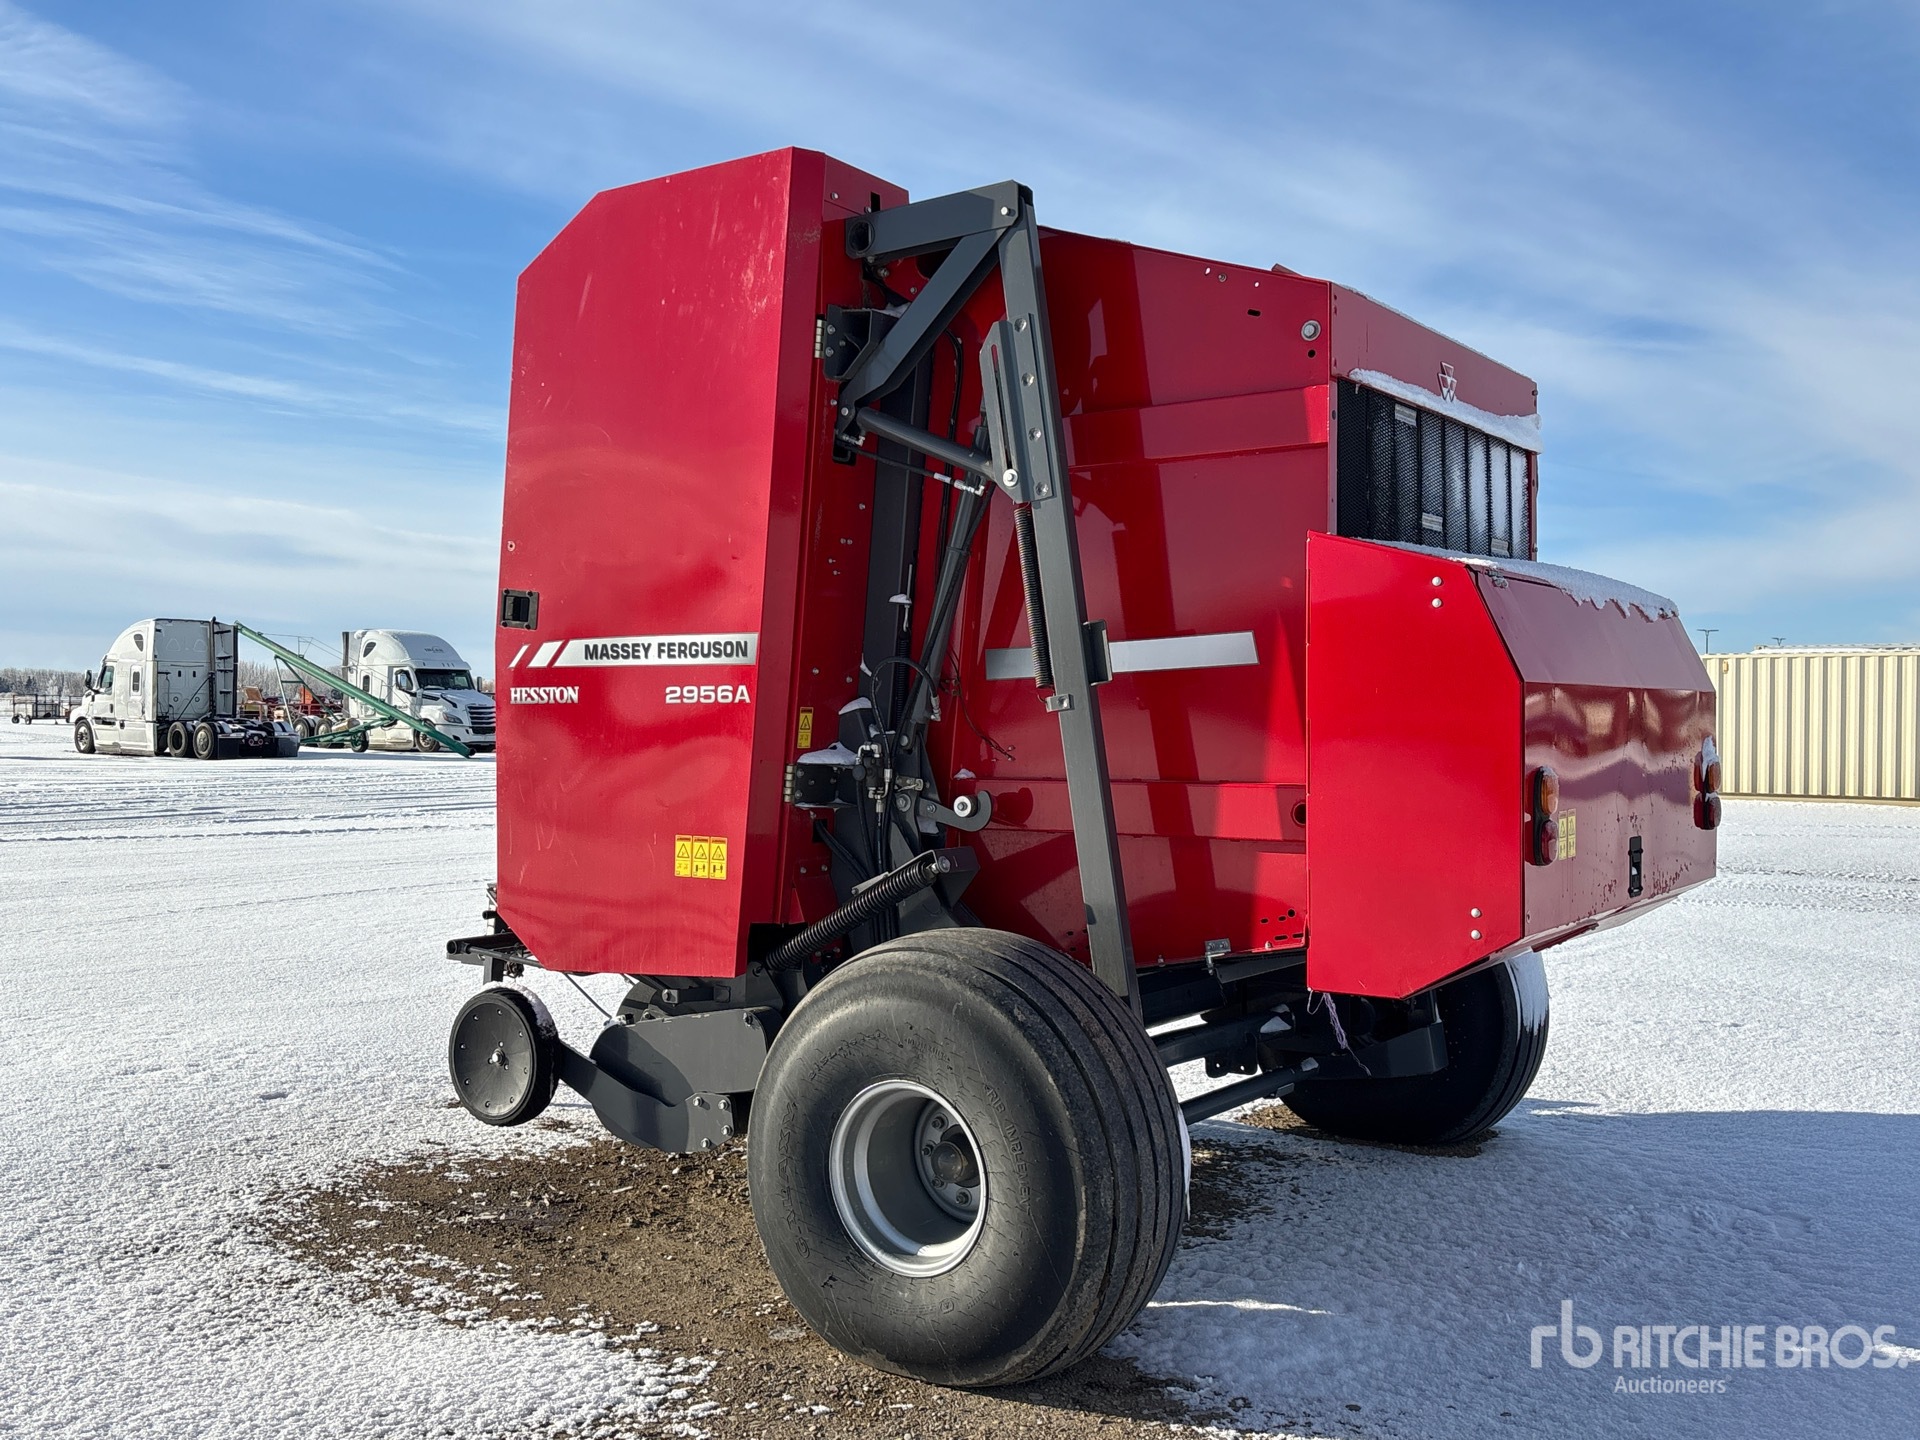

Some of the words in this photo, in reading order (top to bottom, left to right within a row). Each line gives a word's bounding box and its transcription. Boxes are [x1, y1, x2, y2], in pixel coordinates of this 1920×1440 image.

[584, 643, 652, 660] MASSEY
[657, 641, 748, 659] FERGUSON
[510, 686, 579, 704] HESSTON
[665, 685, 751, 704] 2956A
